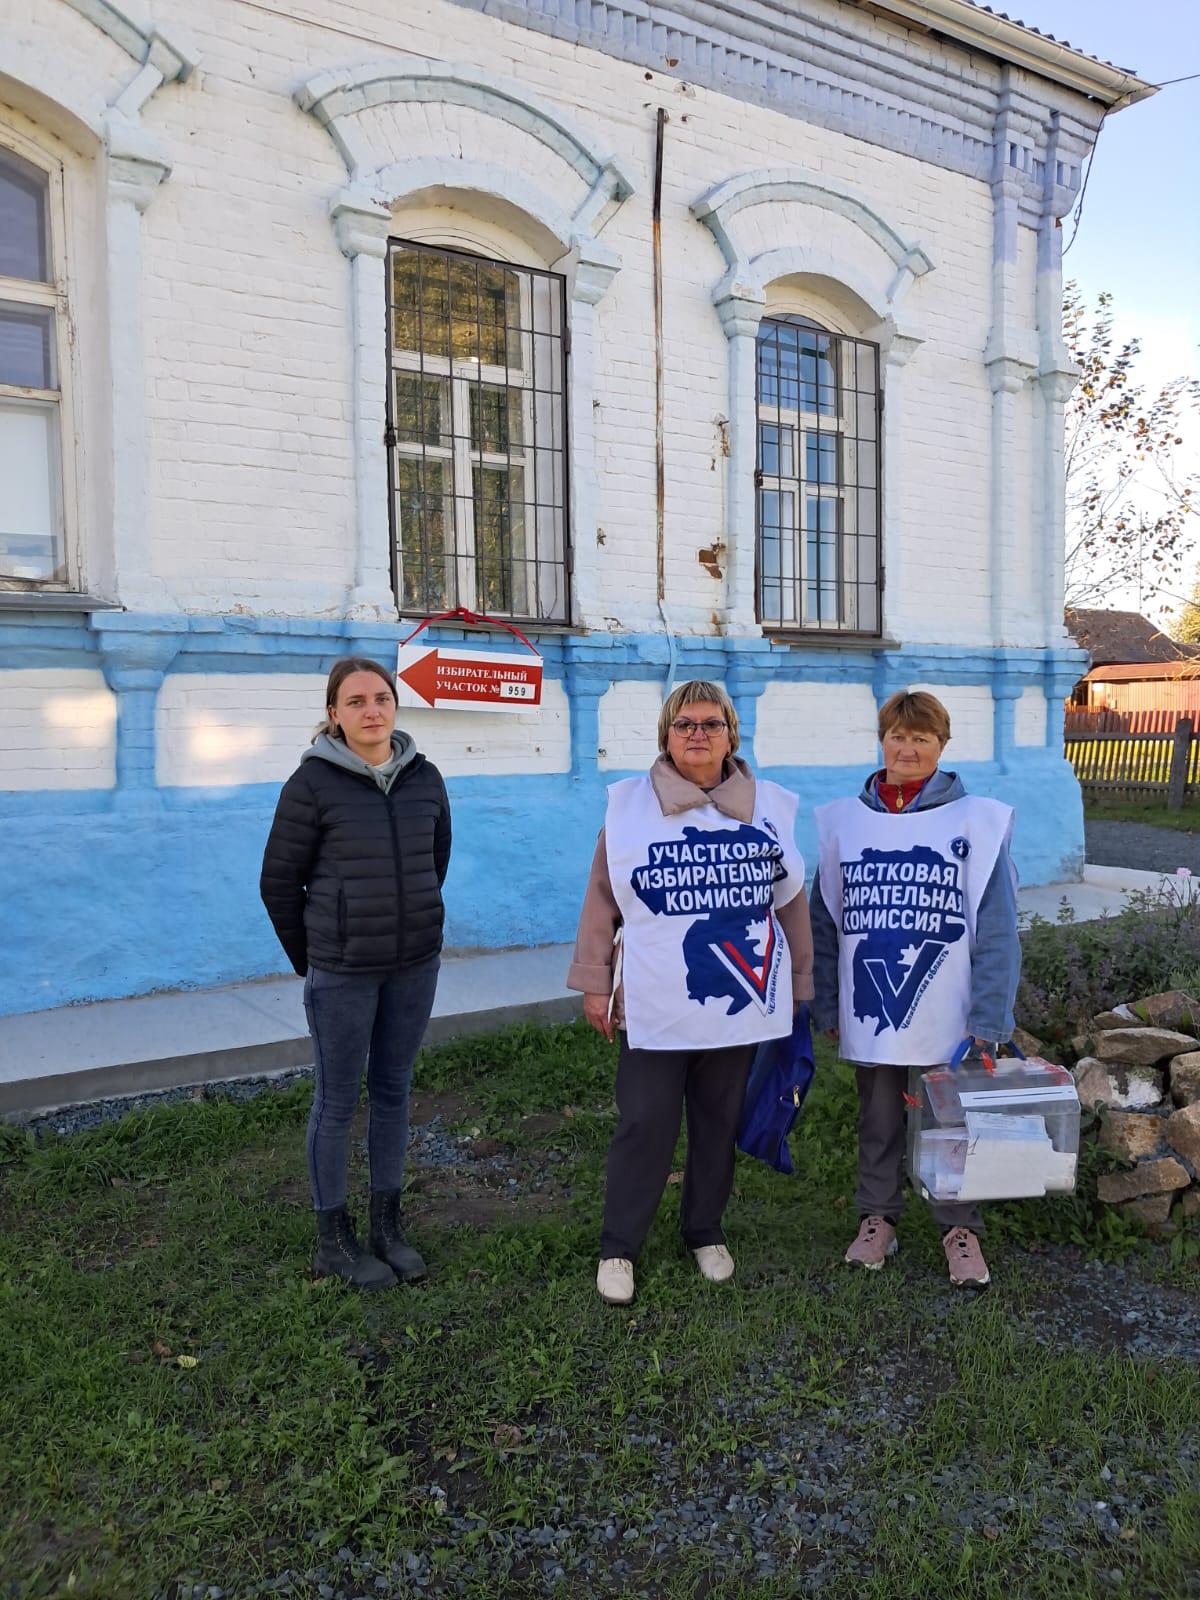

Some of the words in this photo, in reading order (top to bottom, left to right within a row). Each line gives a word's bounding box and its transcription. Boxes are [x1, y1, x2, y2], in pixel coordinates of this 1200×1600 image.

[436, 665, 528, 681] ИЗБИРАТЕЛЬНЫЙ
[435, 680, 488, 694] УЧАСТОК
[489, 684, 500, 694] №
[508, 685, 526, 697] 959
[842, 862, 955, 887] ЧАСТКОВАЯ
[665, 884, 771, 911] КОМИССИЯ
[843, 907, 941, 933] КОМИССИЯ
[929, 949, 950, 980] область
